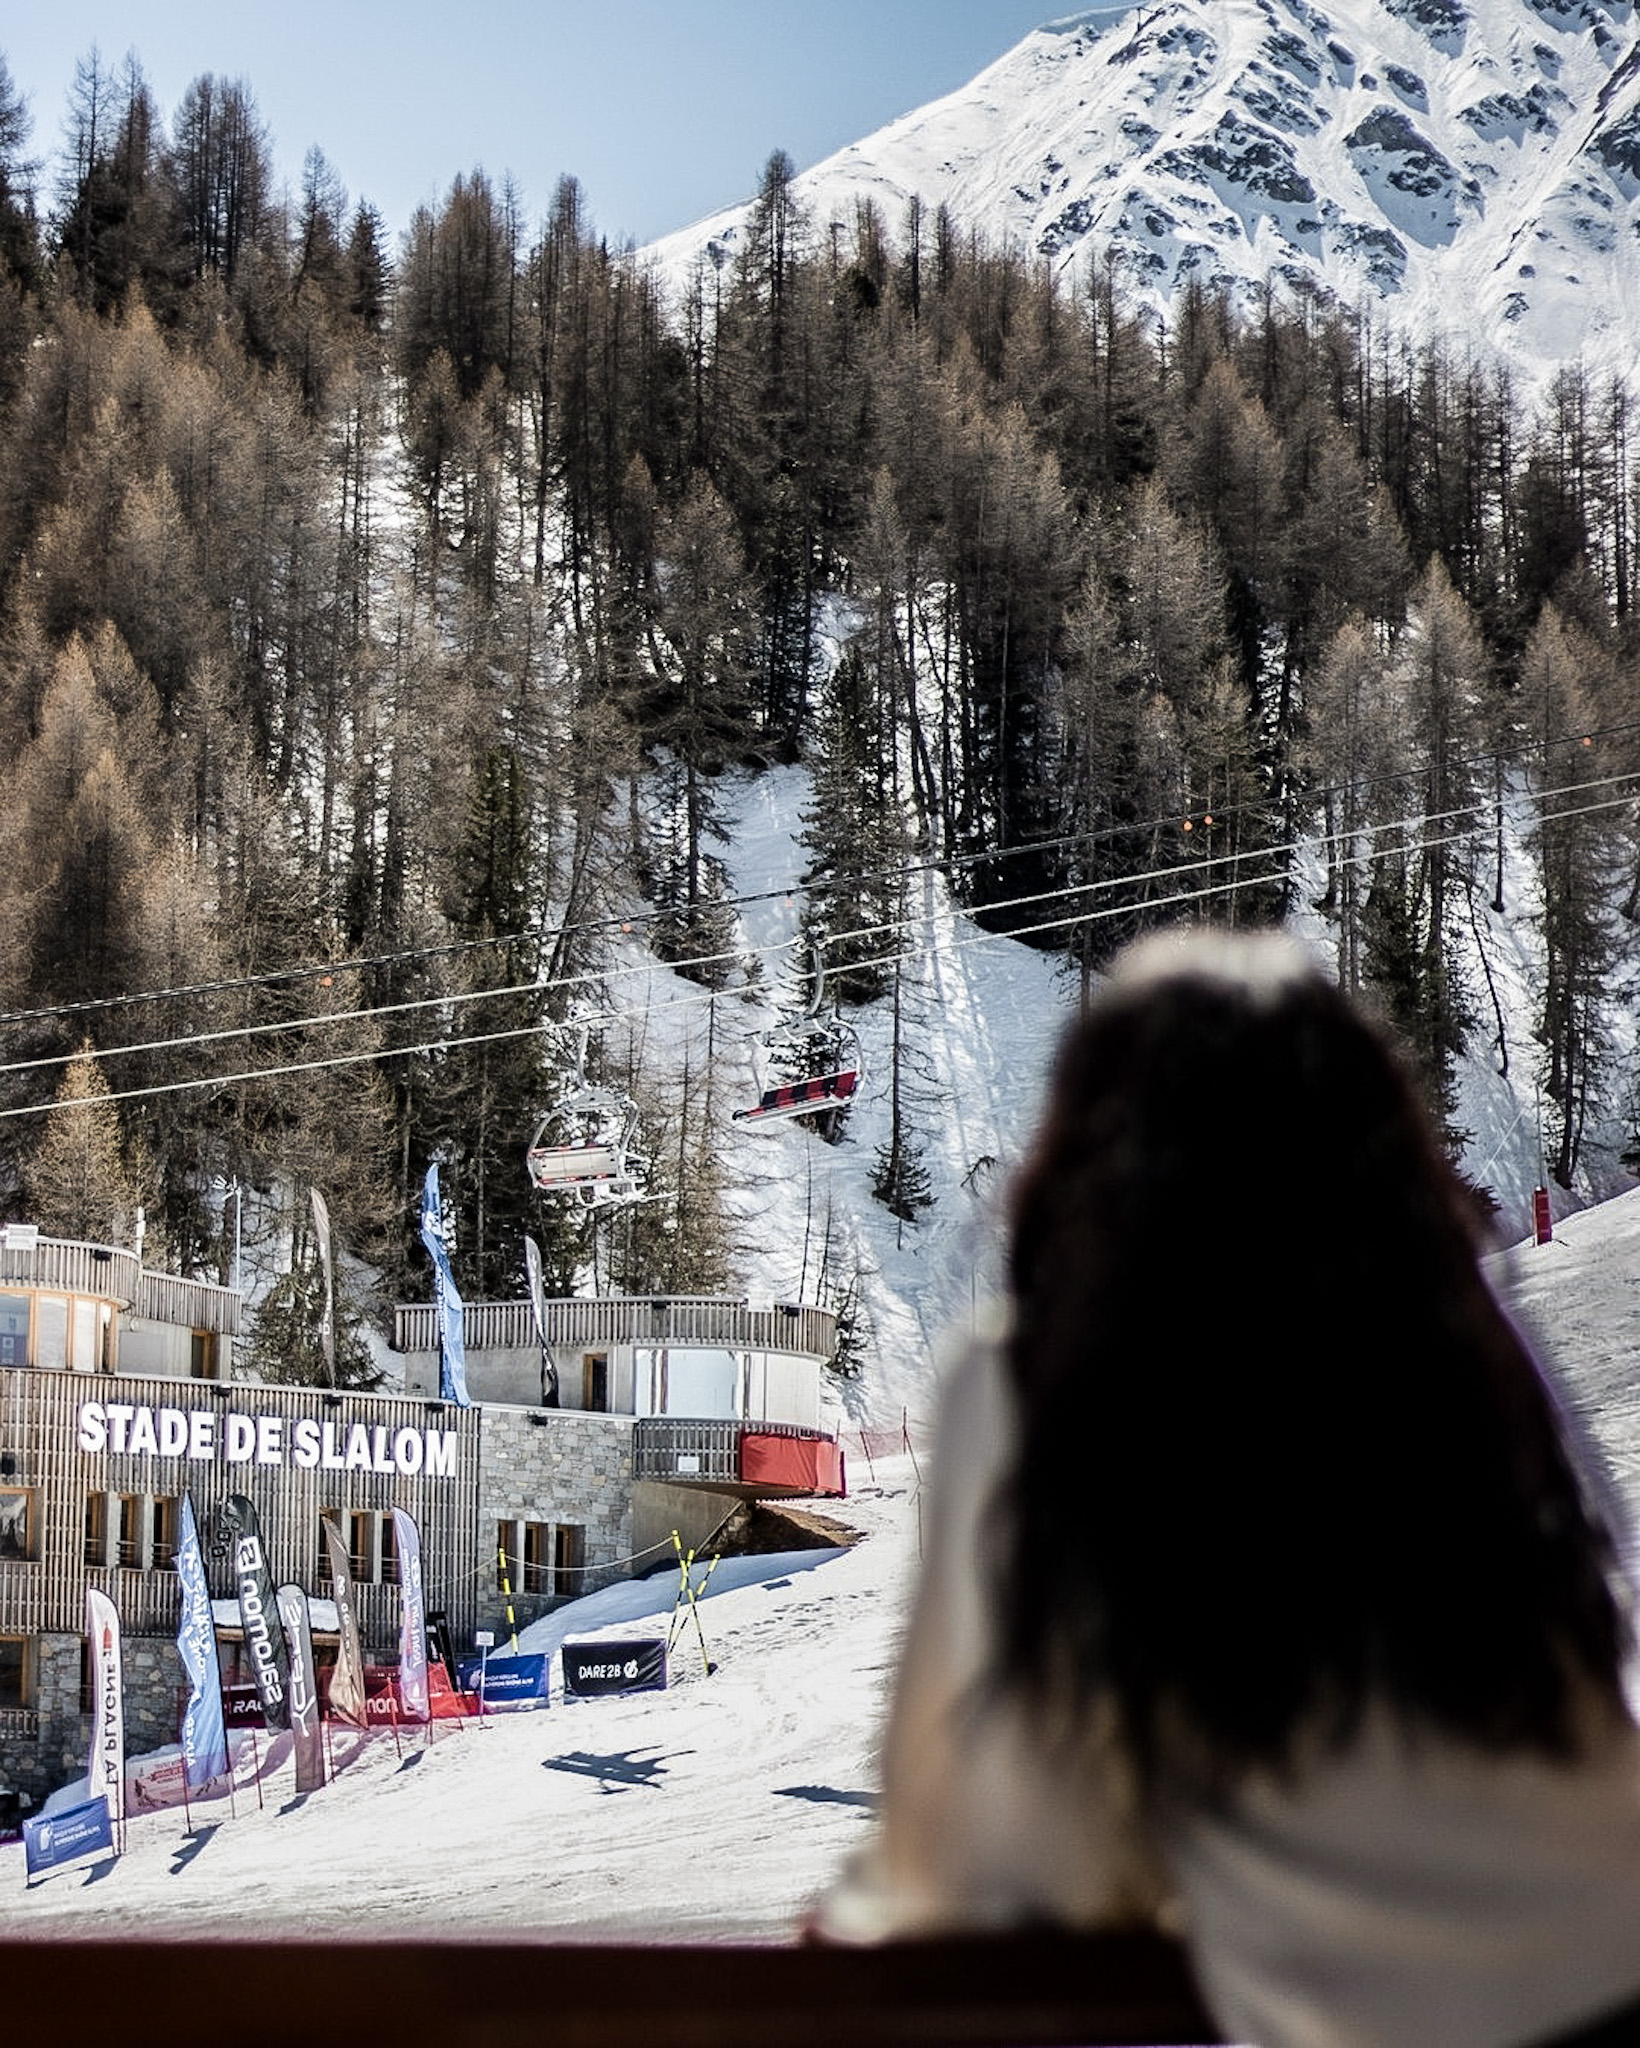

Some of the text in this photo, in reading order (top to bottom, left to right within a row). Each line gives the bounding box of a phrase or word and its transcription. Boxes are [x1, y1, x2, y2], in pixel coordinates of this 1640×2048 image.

[79, 1401, 458, 1478] STADE DE SLALOM
